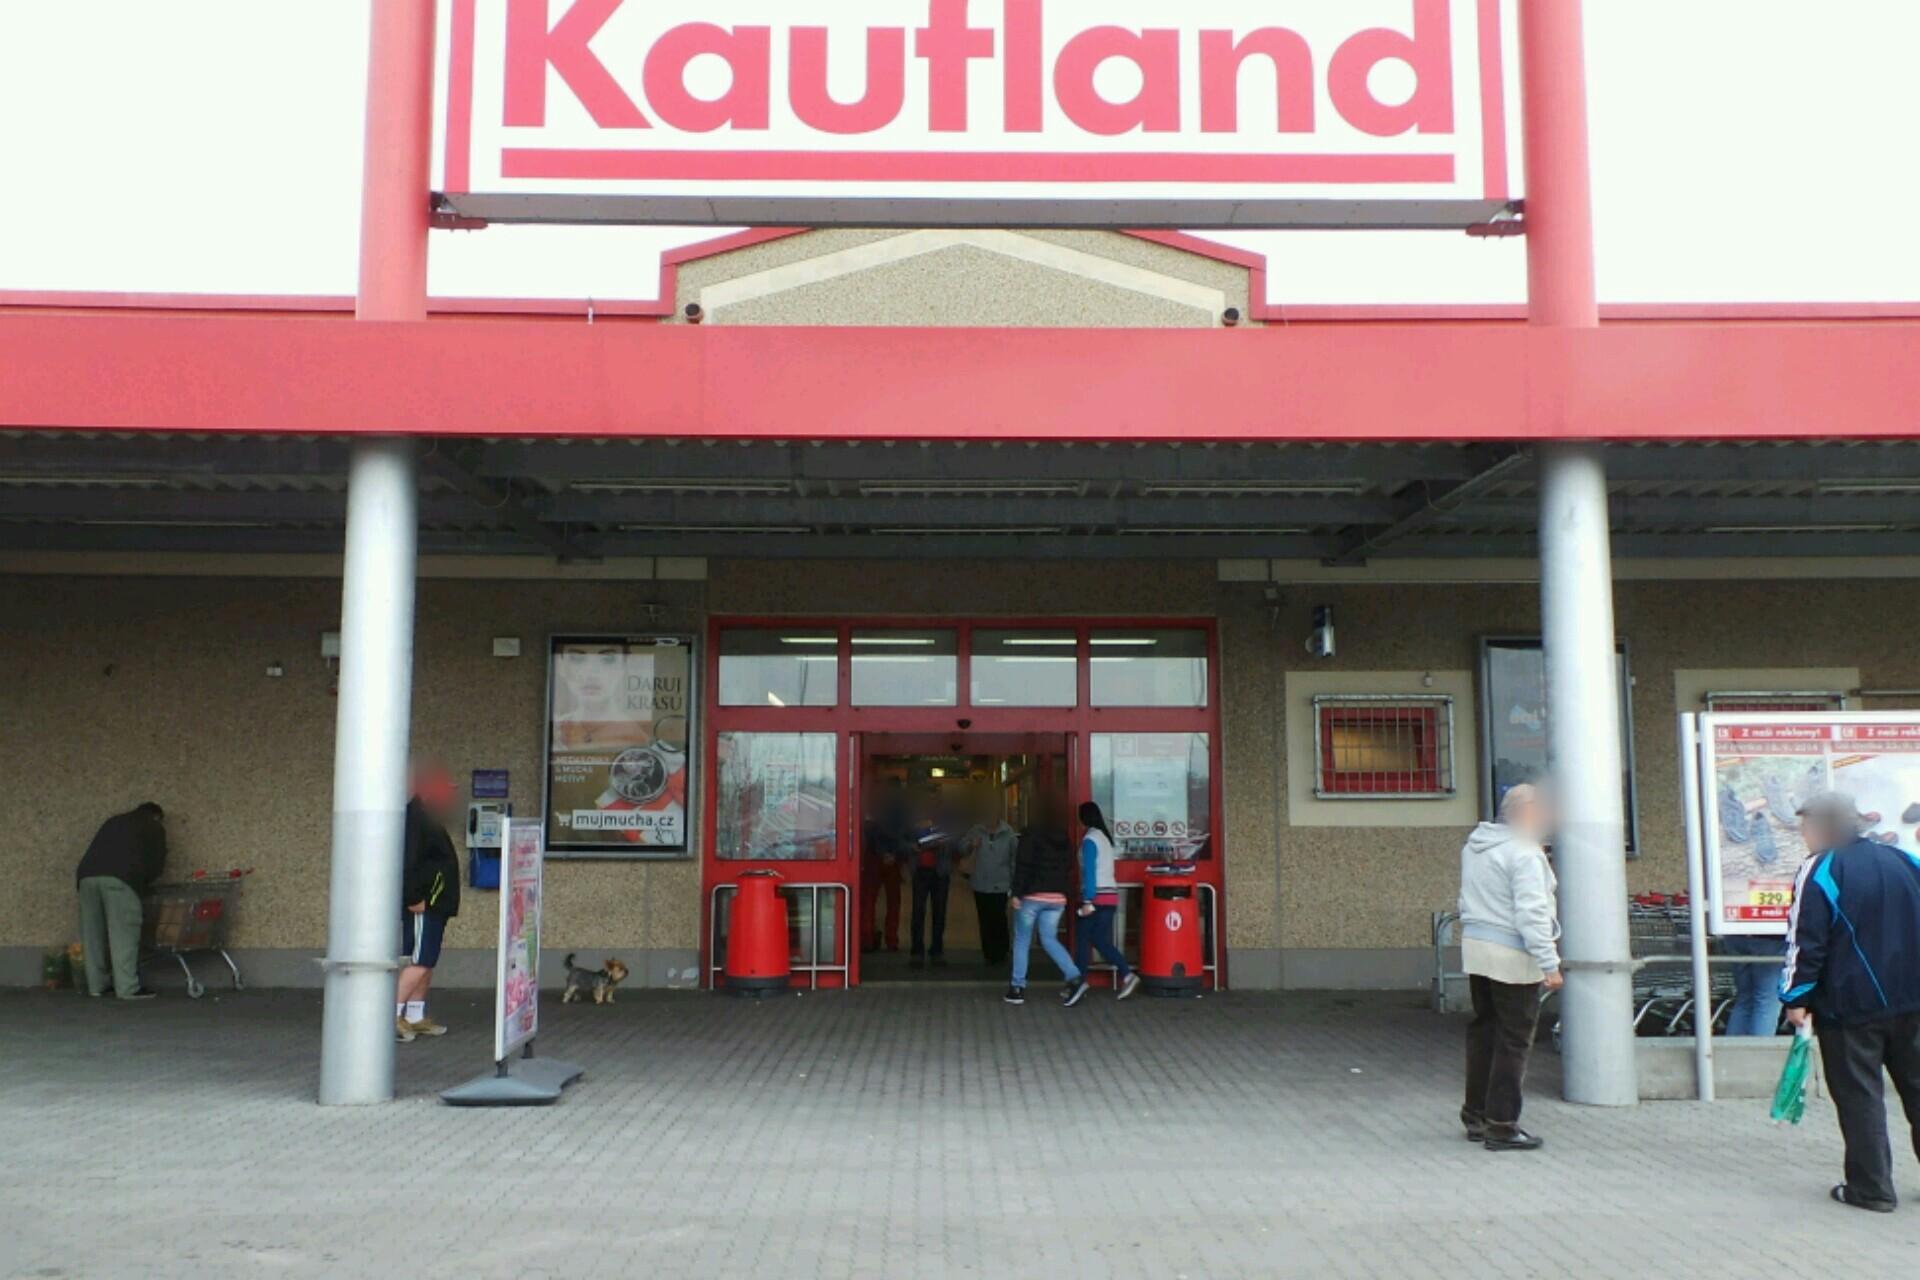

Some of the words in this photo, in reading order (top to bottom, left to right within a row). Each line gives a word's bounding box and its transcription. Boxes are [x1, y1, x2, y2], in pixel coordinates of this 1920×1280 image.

[501, 0, 1455, 135] Kaufland
[627, 675, 681, 692] DARUJ
[576, 812, 674, 828] mujmucha.cz
